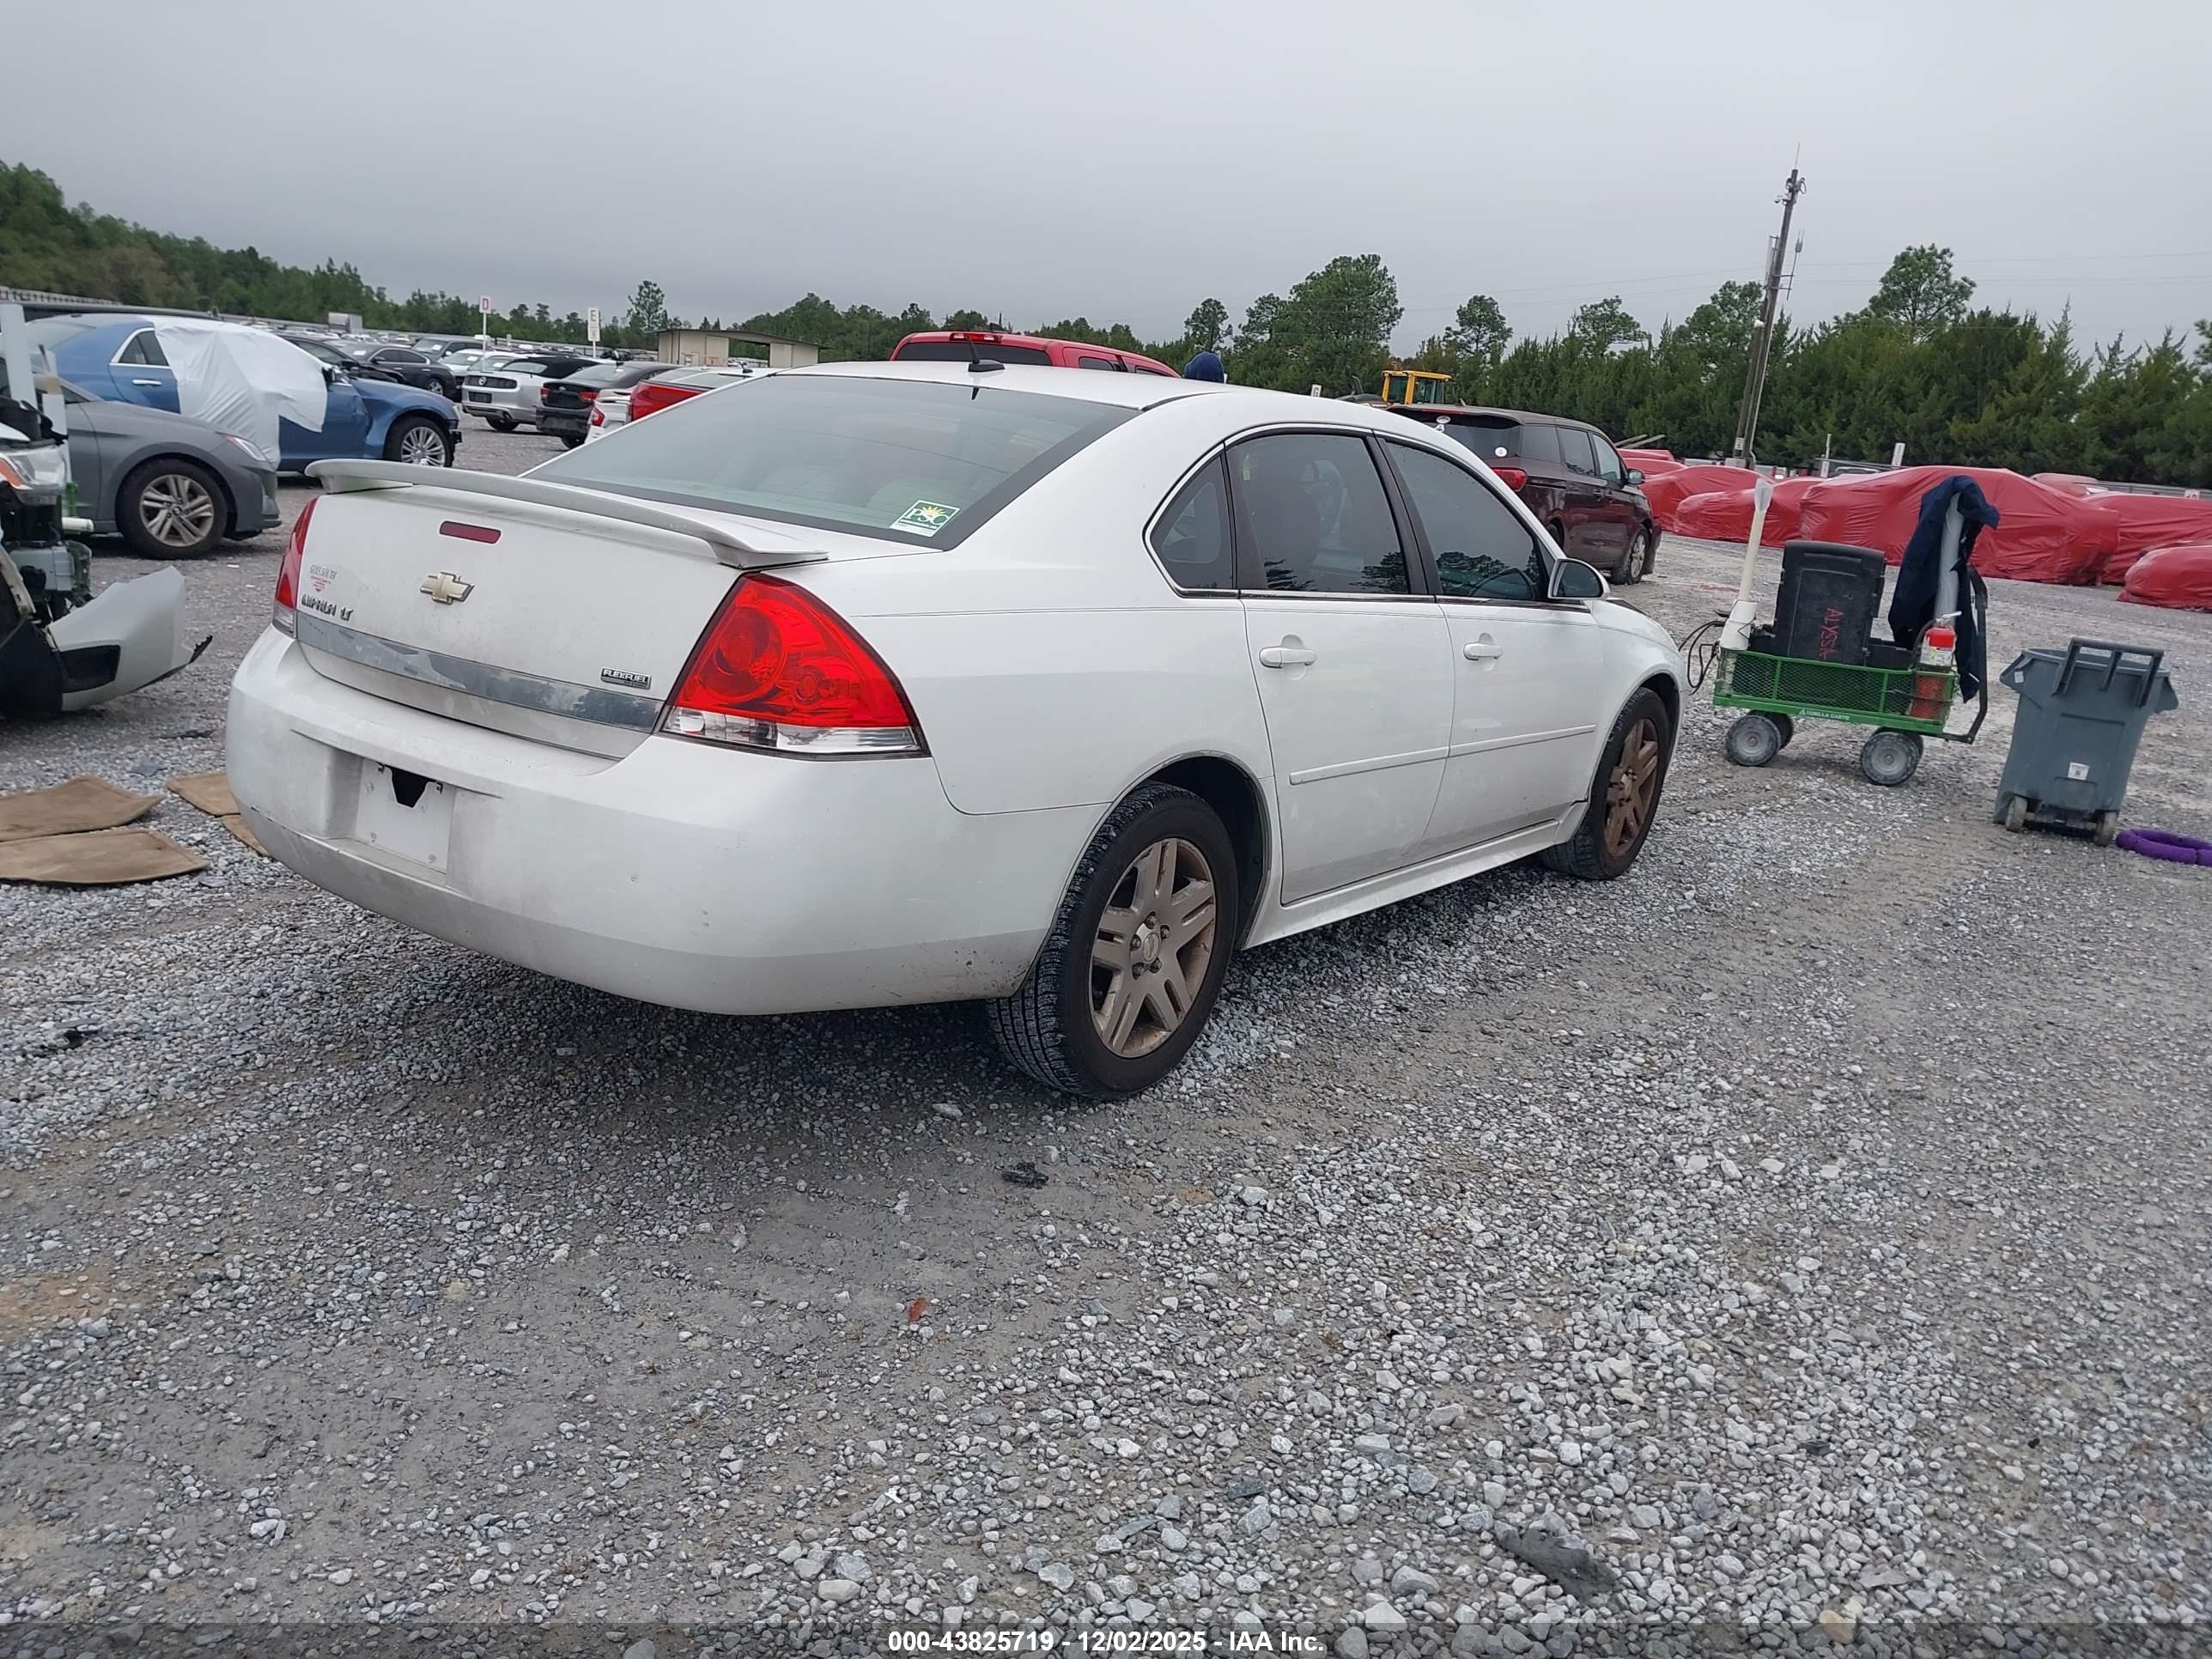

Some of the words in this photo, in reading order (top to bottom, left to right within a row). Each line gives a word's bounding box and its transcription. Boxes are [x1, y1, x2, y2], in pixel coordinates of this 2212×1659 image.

[482, 298, 489, 310] D
[590, 309, 597, 322] E
[1819, 607, 1844, 659] ALYSSA
